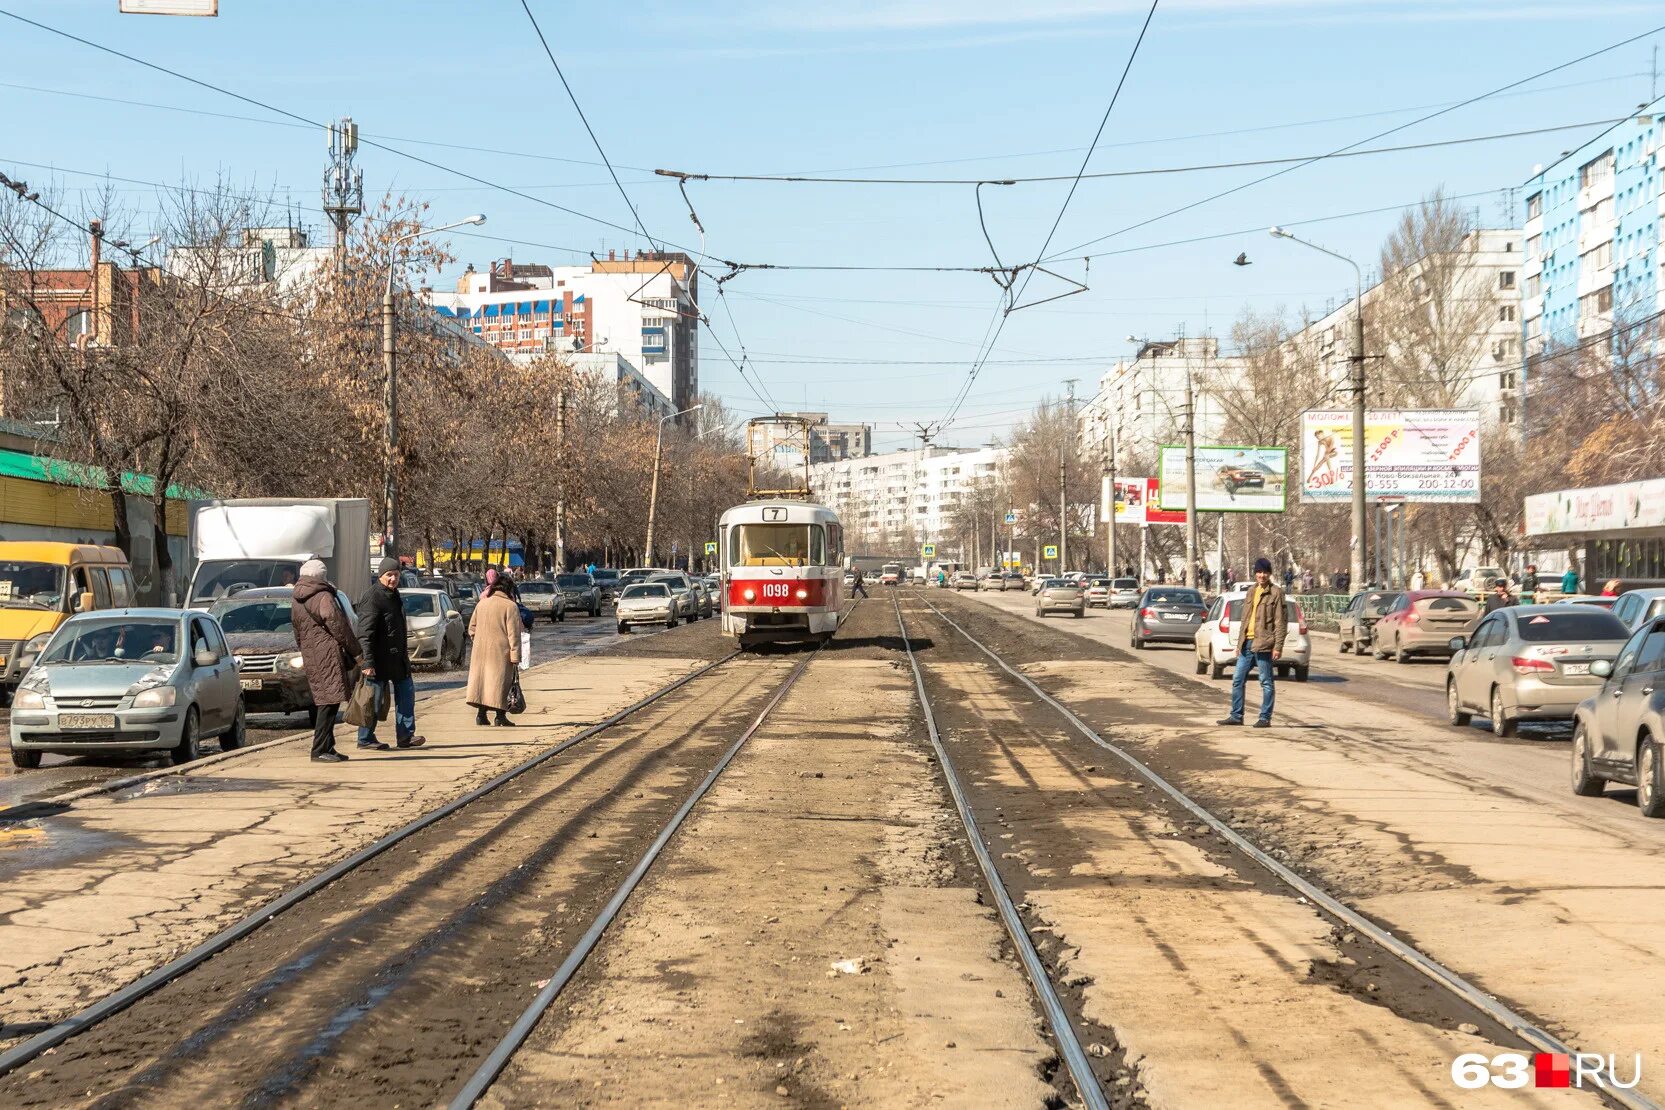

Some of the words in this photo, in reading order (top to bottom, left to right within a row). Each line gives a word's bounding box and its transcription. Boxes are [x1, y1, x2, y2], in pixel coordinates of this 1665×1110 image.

[1308, 467, 1345, 489] -30%
[1418, 479, 1475, 489] 200-12-00
[771, 510, 779, 520] 7
[763, 583, 789, 598] 1098
